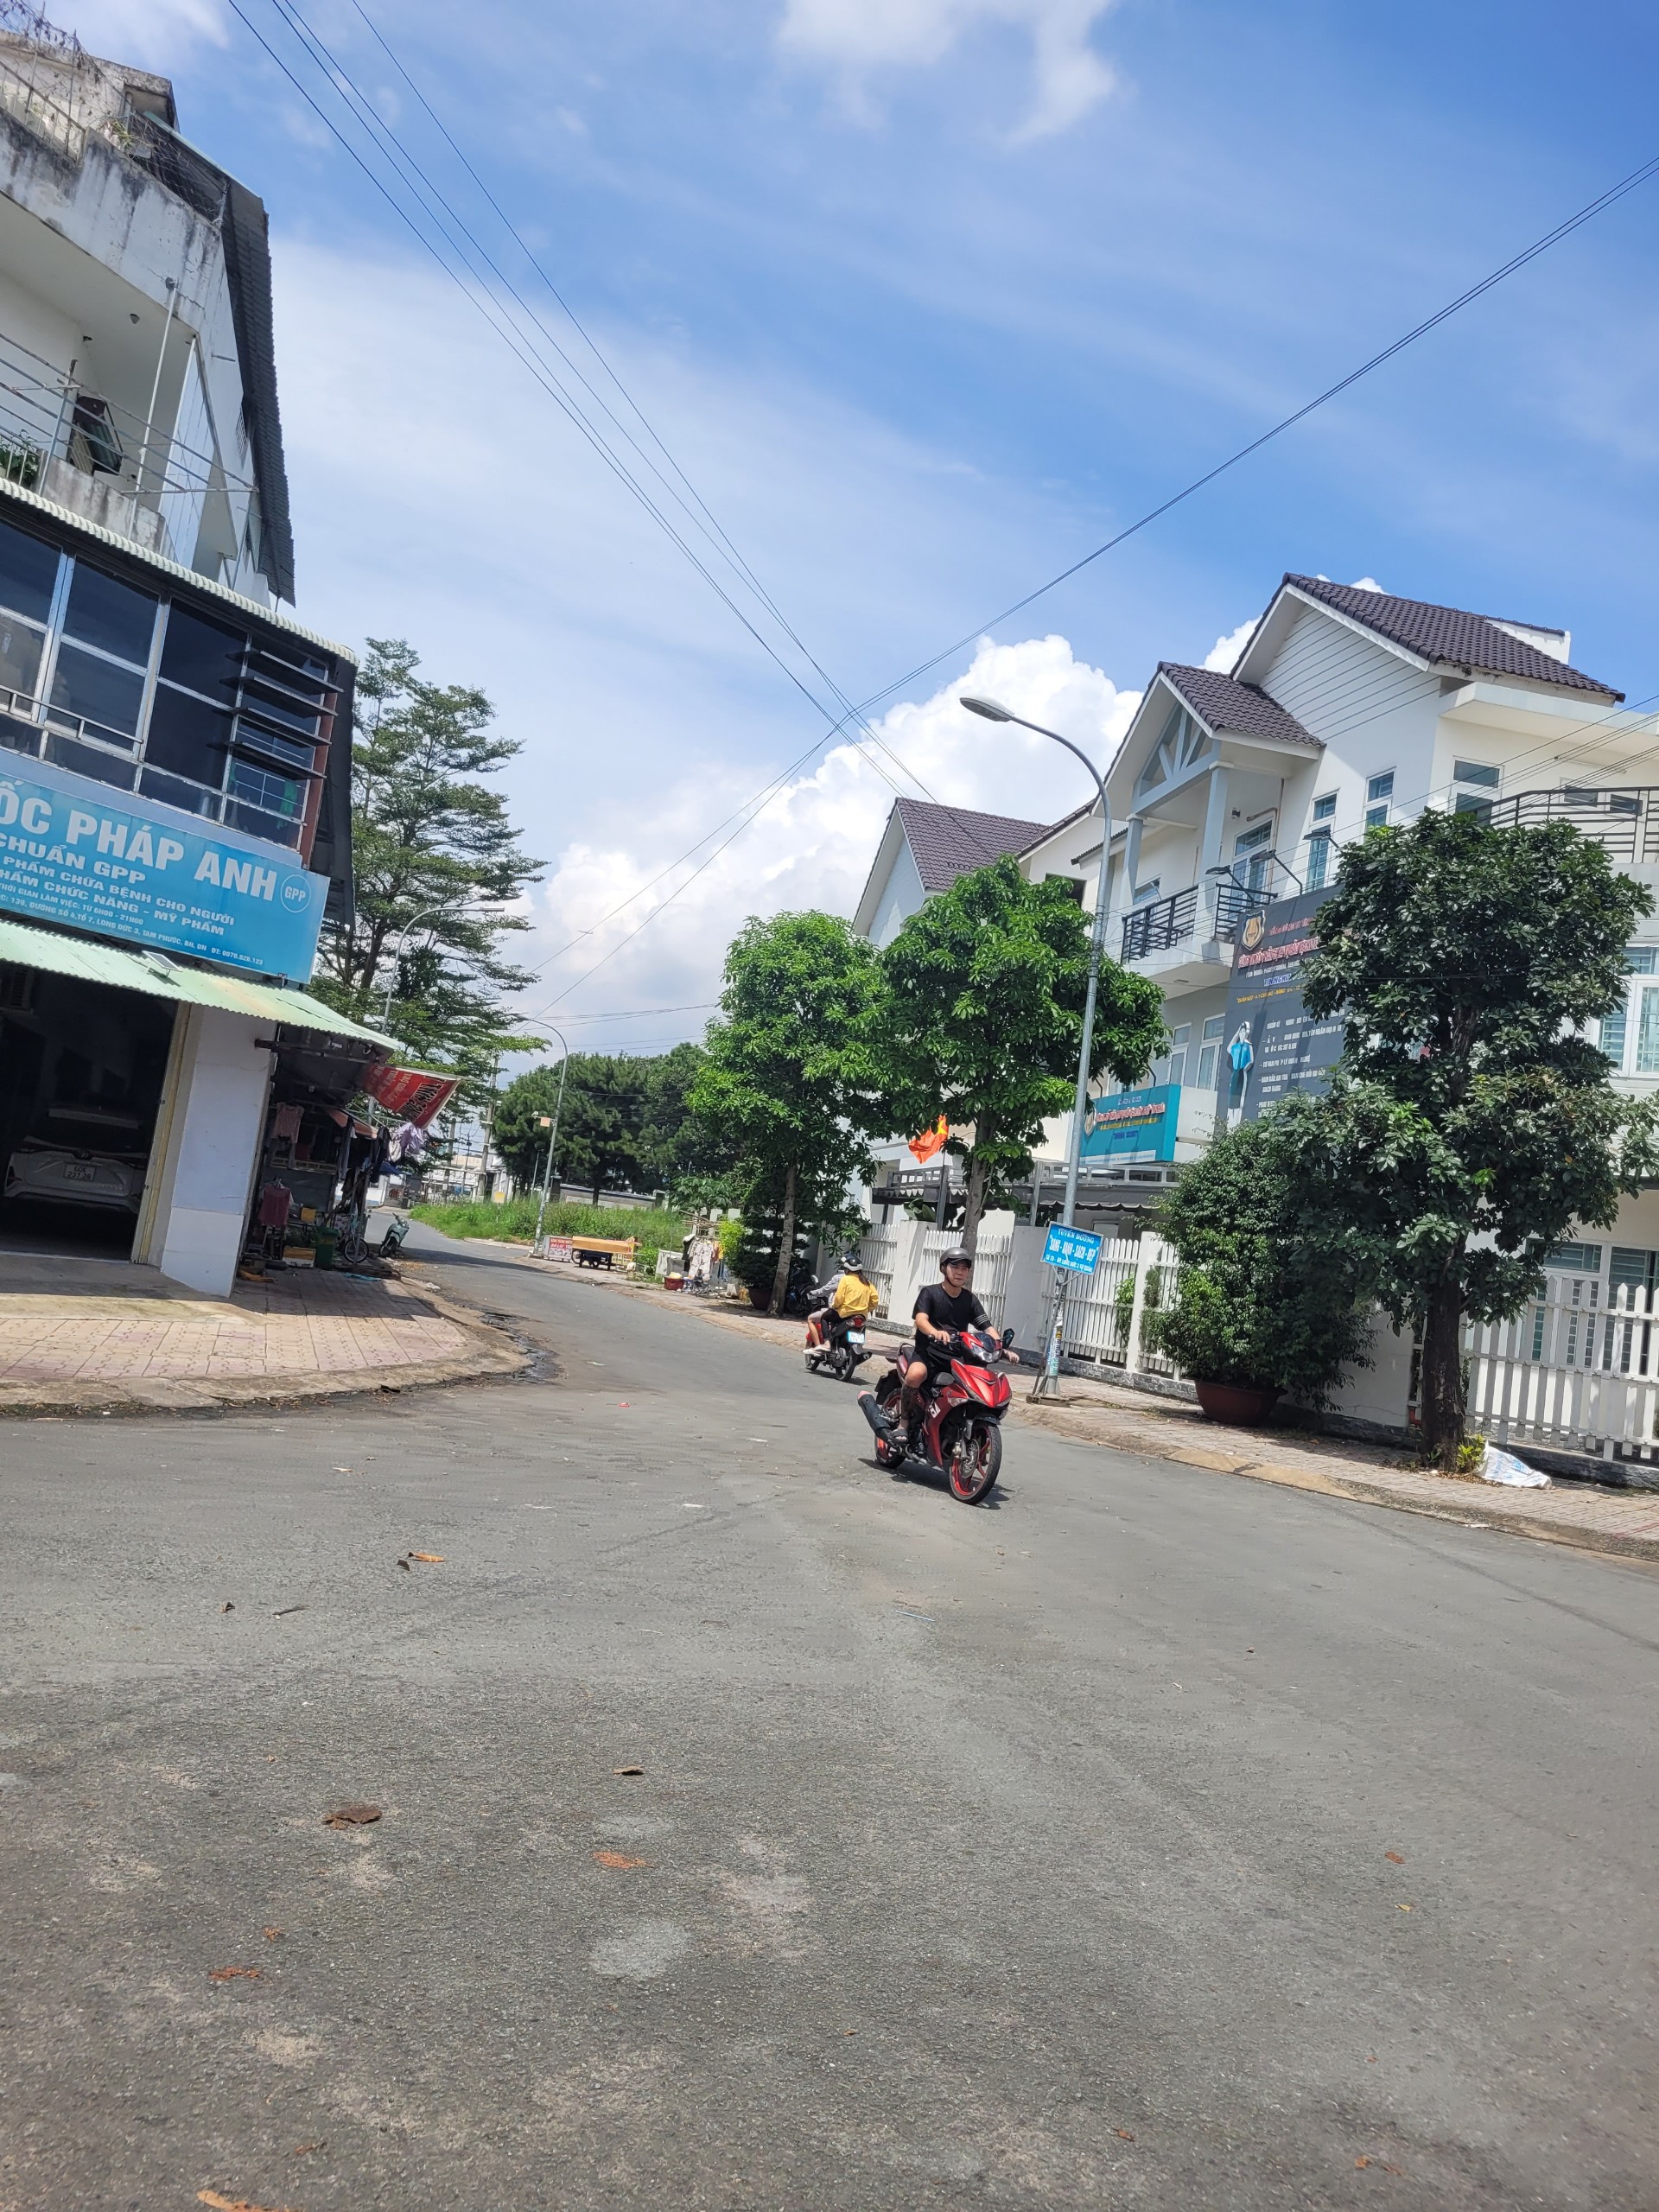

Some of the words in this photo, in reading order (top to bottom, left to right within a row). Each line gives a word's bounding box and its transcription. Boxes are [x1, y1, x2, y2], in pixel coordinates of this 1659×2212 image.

[66, 810, 184, 870] PHÁP
[194, 851, 277, 901] ANH
[93, 861, 146, 884] GPP
[18, 887, 39, 899] GIAN
[41, 893, 58, 904] LÀM
[44, 881, 89, 900] CHỨC
[93, 894, 139, 913] NĂNG
[154, 910, 178, 924] MỸ
[60, 872, 104, 891] CHỮA
[109, 884, 151, 904] BỆNH
[156, 898, 187, 912] CHO
[190, 906, 235, 925] NGƯỜI
[284, 886, 306, 902] GPP
[97, 918, 117, 929] LONG
[118, 923, 133, 933] ĐỨC
[142, 930, 157, 939] TAM
[1058, 1228, 1075, 1238] TUYẾN
[1076, 1233, 1095, 1244] ĐƯỜNG
